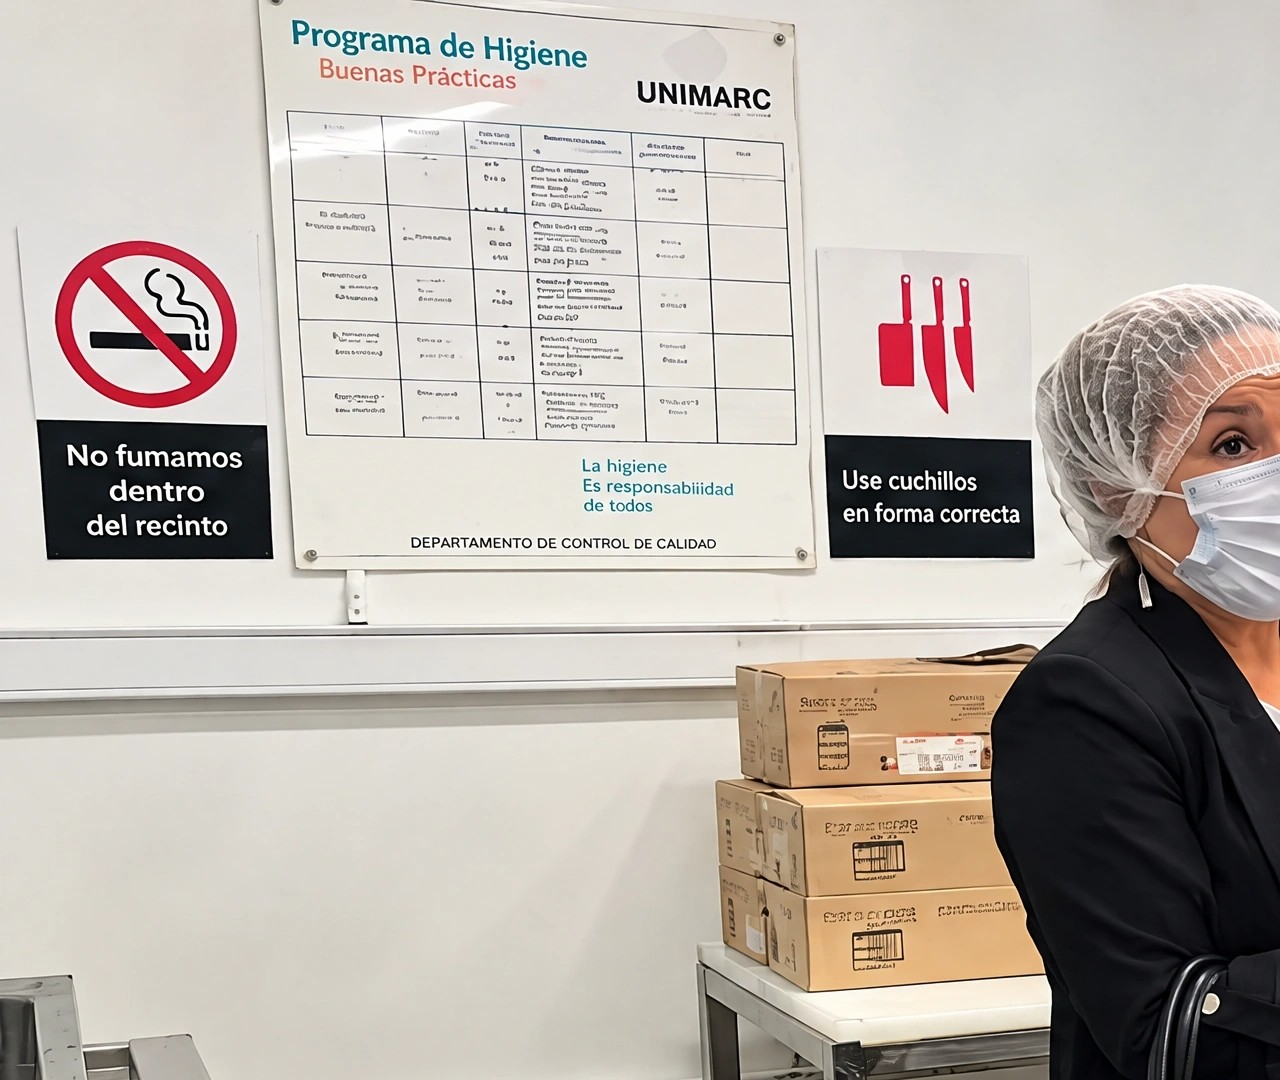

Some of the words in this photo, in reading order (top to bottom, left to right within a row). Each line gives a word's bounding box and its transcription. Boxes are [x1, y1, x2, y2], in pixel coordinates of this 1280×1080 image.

[292, 20, 431, 55] Programa
[440, 32, 474, 58] de
[484, 36, 587, 70] Higiene
[320, 58, 404, 83] Buenas
[413, 66, 517, 89] Prácticas
[638, 81, 770, 110] UNIMARC
[67, 445, 107, 466] No
[116, 444, 242, 468] fumamos
[583, 459, 600, 472] La
[608, 459, 666, 476] higiene
[110, 479, 204, 502] dentro
[584, 479, 600, 492] Es
[843, 470, 882, 490] Use
[889, 470, 977, 491] cuchillos
[584, 499, 603, 511] de
[610, 499, 652, 512] todos
[844, 508, 868, 522] en
[874, 502, 934, 522] forma
[941, 506, 1020, 523] correcta
[87, 514, 127, 535] del
[136, 514, 227, 535] recinto
[411, 537, 532, 548] DEPARTAMENTO
[538, 538, 556, 548] DE
[562, 538, 629, 549] CONTROL
[635, 539, 652, 549] DE
[657, 539, 716, 549] CALIDAD
